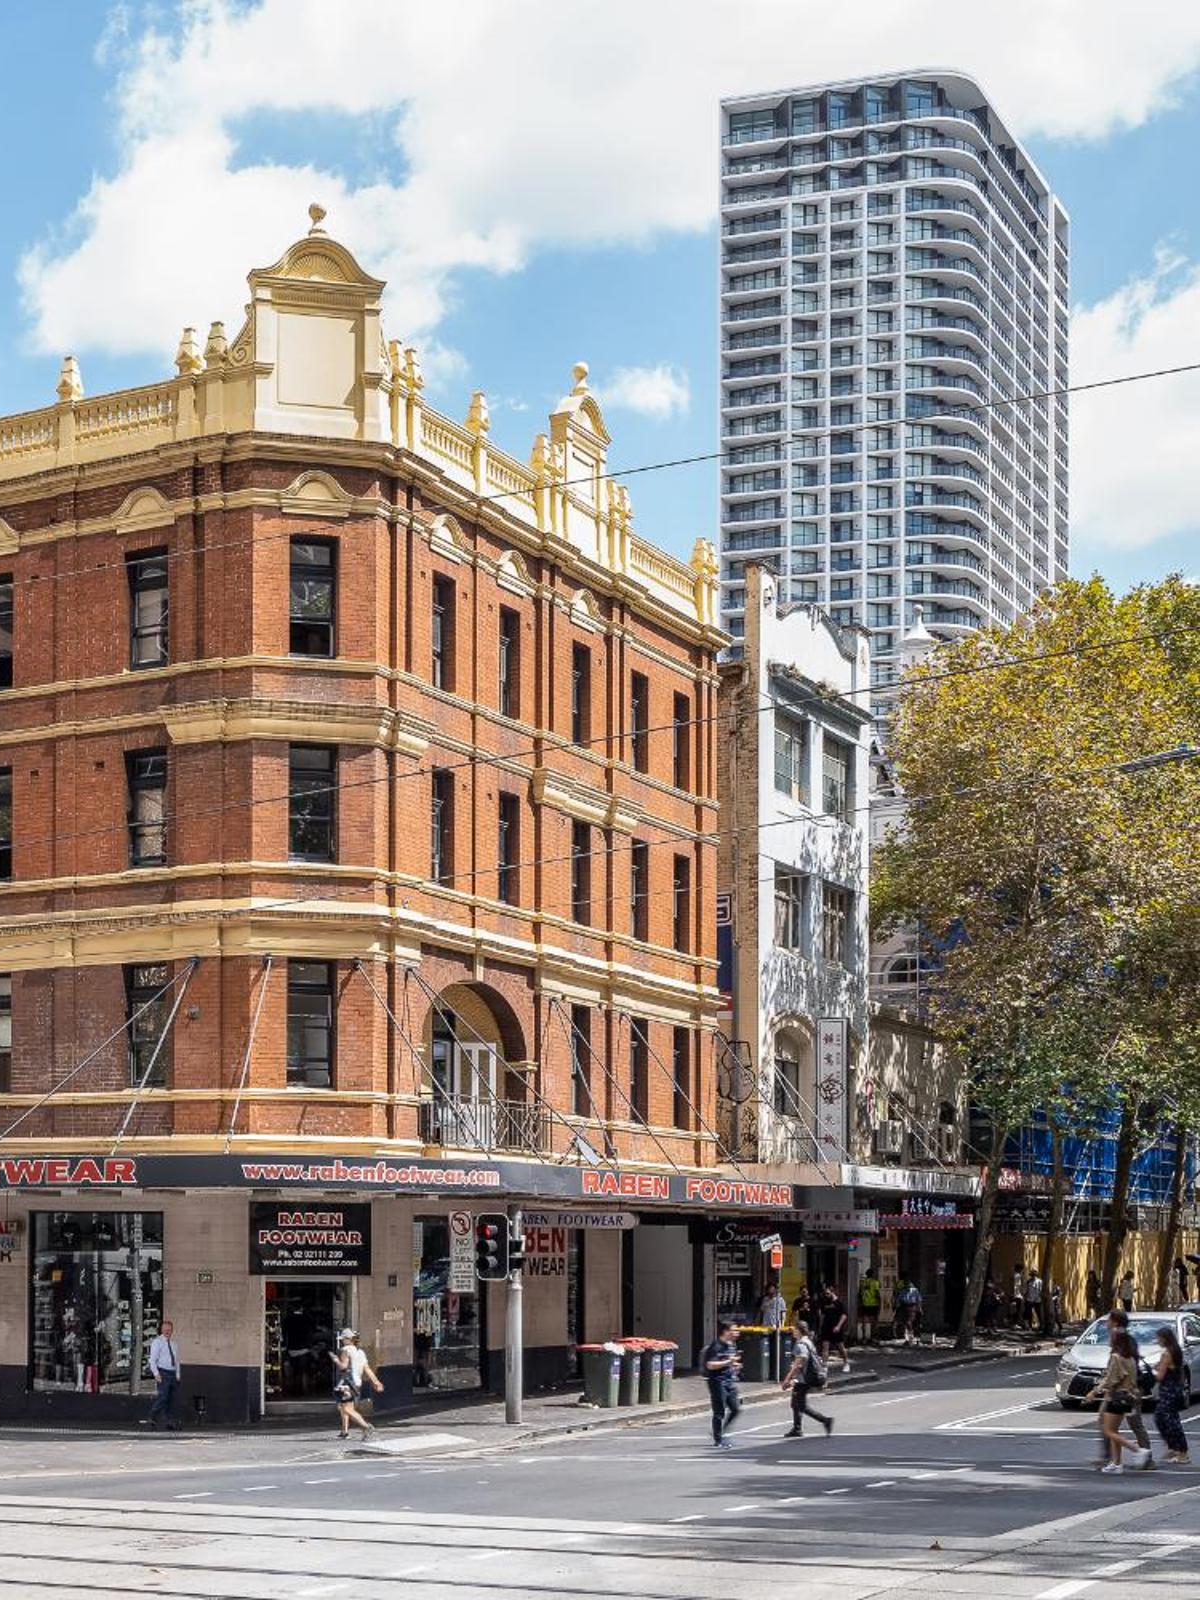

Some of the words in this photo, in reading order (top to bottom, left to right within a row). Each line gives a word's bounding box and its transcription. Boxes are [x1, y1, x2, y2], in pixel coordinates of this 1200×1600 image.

[242, 1160, 499, 1186] www.rabenfootwear.com
[582, 1170, 669, 1198] RABEN
[686, 1178, 792, 1207] FOOTWEAR
[278, 1212, 343, 1226] RABEN
[521, 1214, 548, 1225] ABEN
[558, 1214, 623, 1226] FOOTWEAR
[258, 1230, 362, 1245] FOOTWEAR
[524, 1227, 565, 1253] BEN
